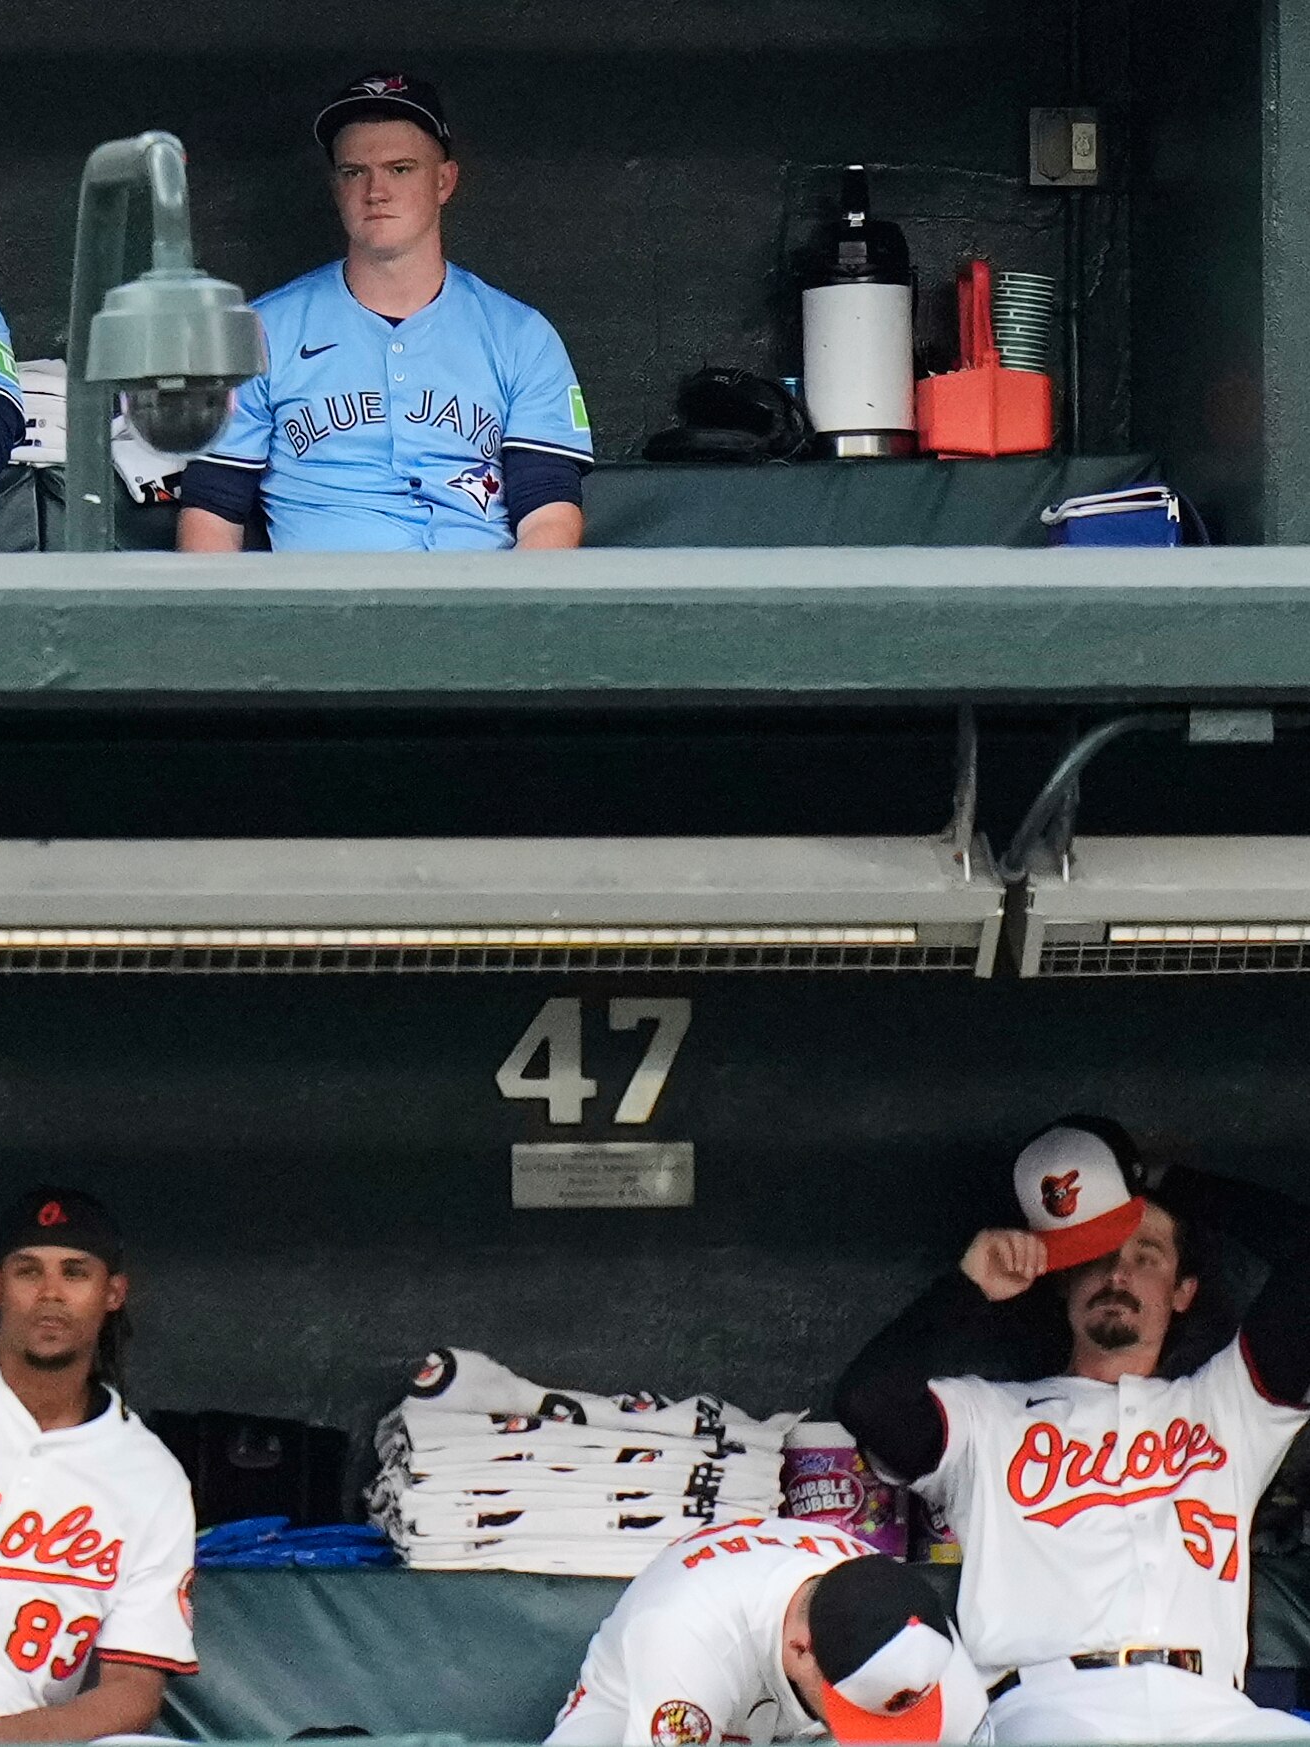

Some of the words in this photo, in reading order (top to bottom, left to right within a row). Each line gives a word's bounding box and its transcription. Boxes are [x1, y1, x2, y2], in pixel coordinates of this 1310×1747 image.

[283, 391, 387, 458] BLUE
[404, 389, 502, 459] JAYS
[495, 997, 691, 1123] 47
[792, 1493, 857, 1517] BUBBLE
[1173, 1499, 1239, 1582] 57
[5, 1599, 101, 1681] 83
